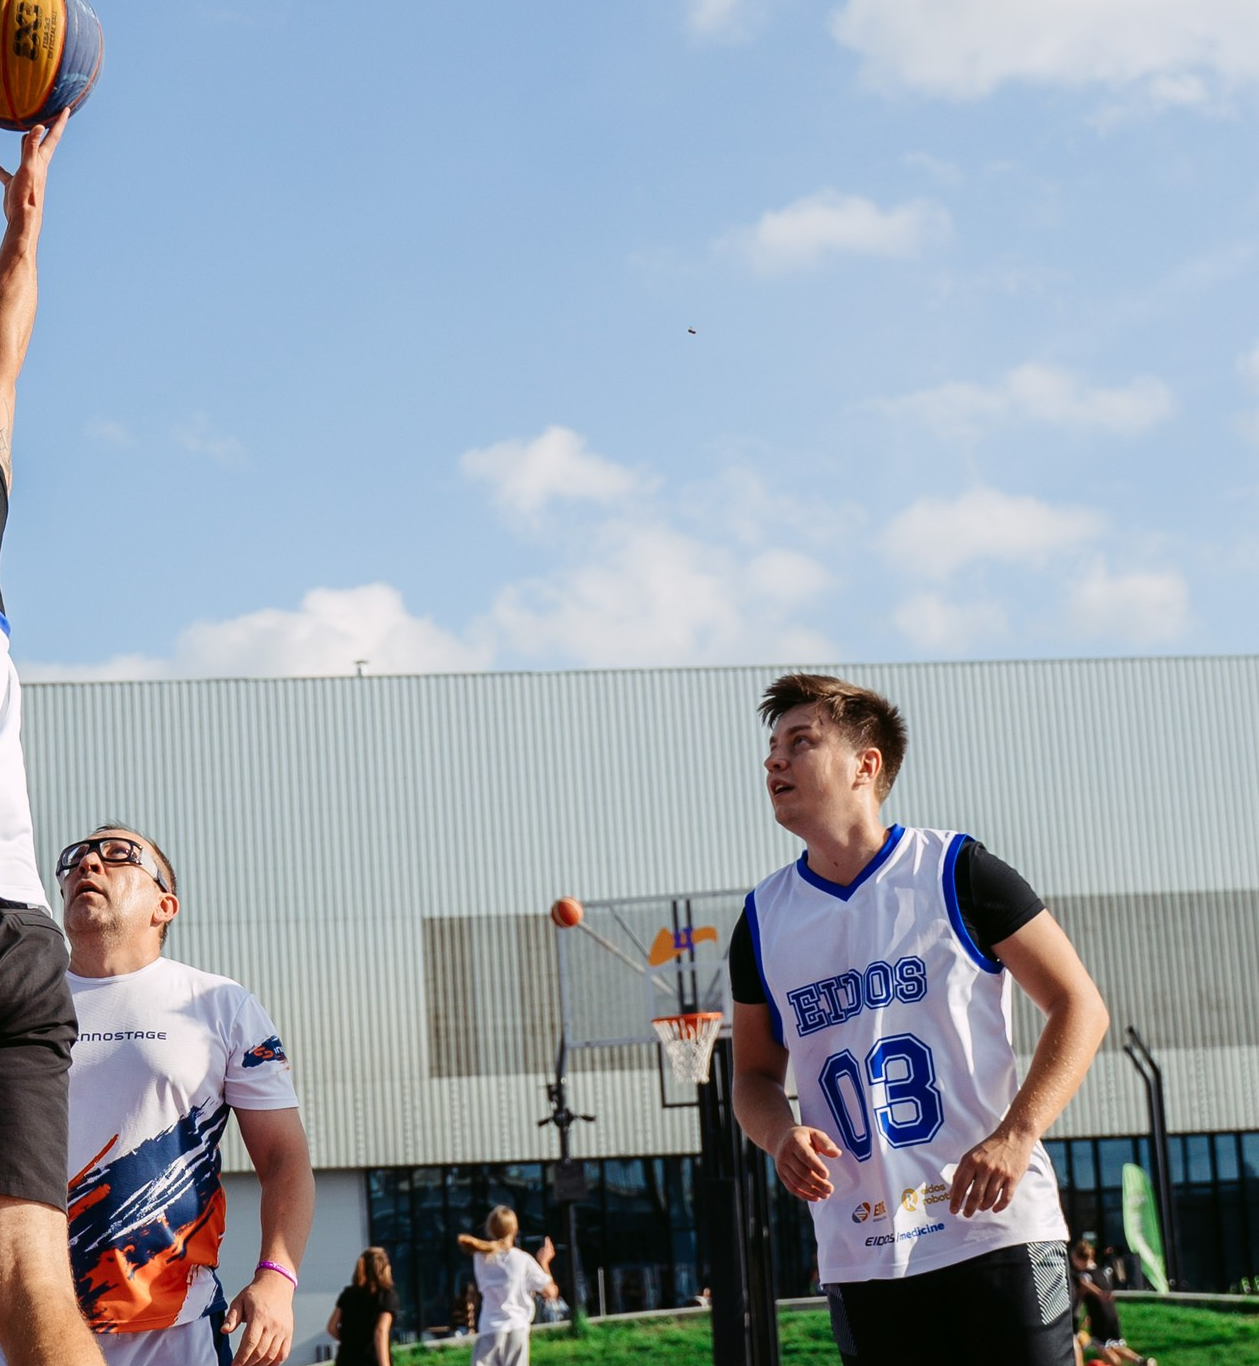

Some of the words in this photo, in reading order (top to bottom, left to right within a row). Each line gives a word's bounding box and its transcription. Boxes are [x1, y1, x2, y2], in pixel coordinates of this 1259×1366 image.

[76, 1030, 167, 1042] NNOSTAGE
[786, 955, 927, 1037] EIDOS
[819, 1032, 944, 1163] 03
